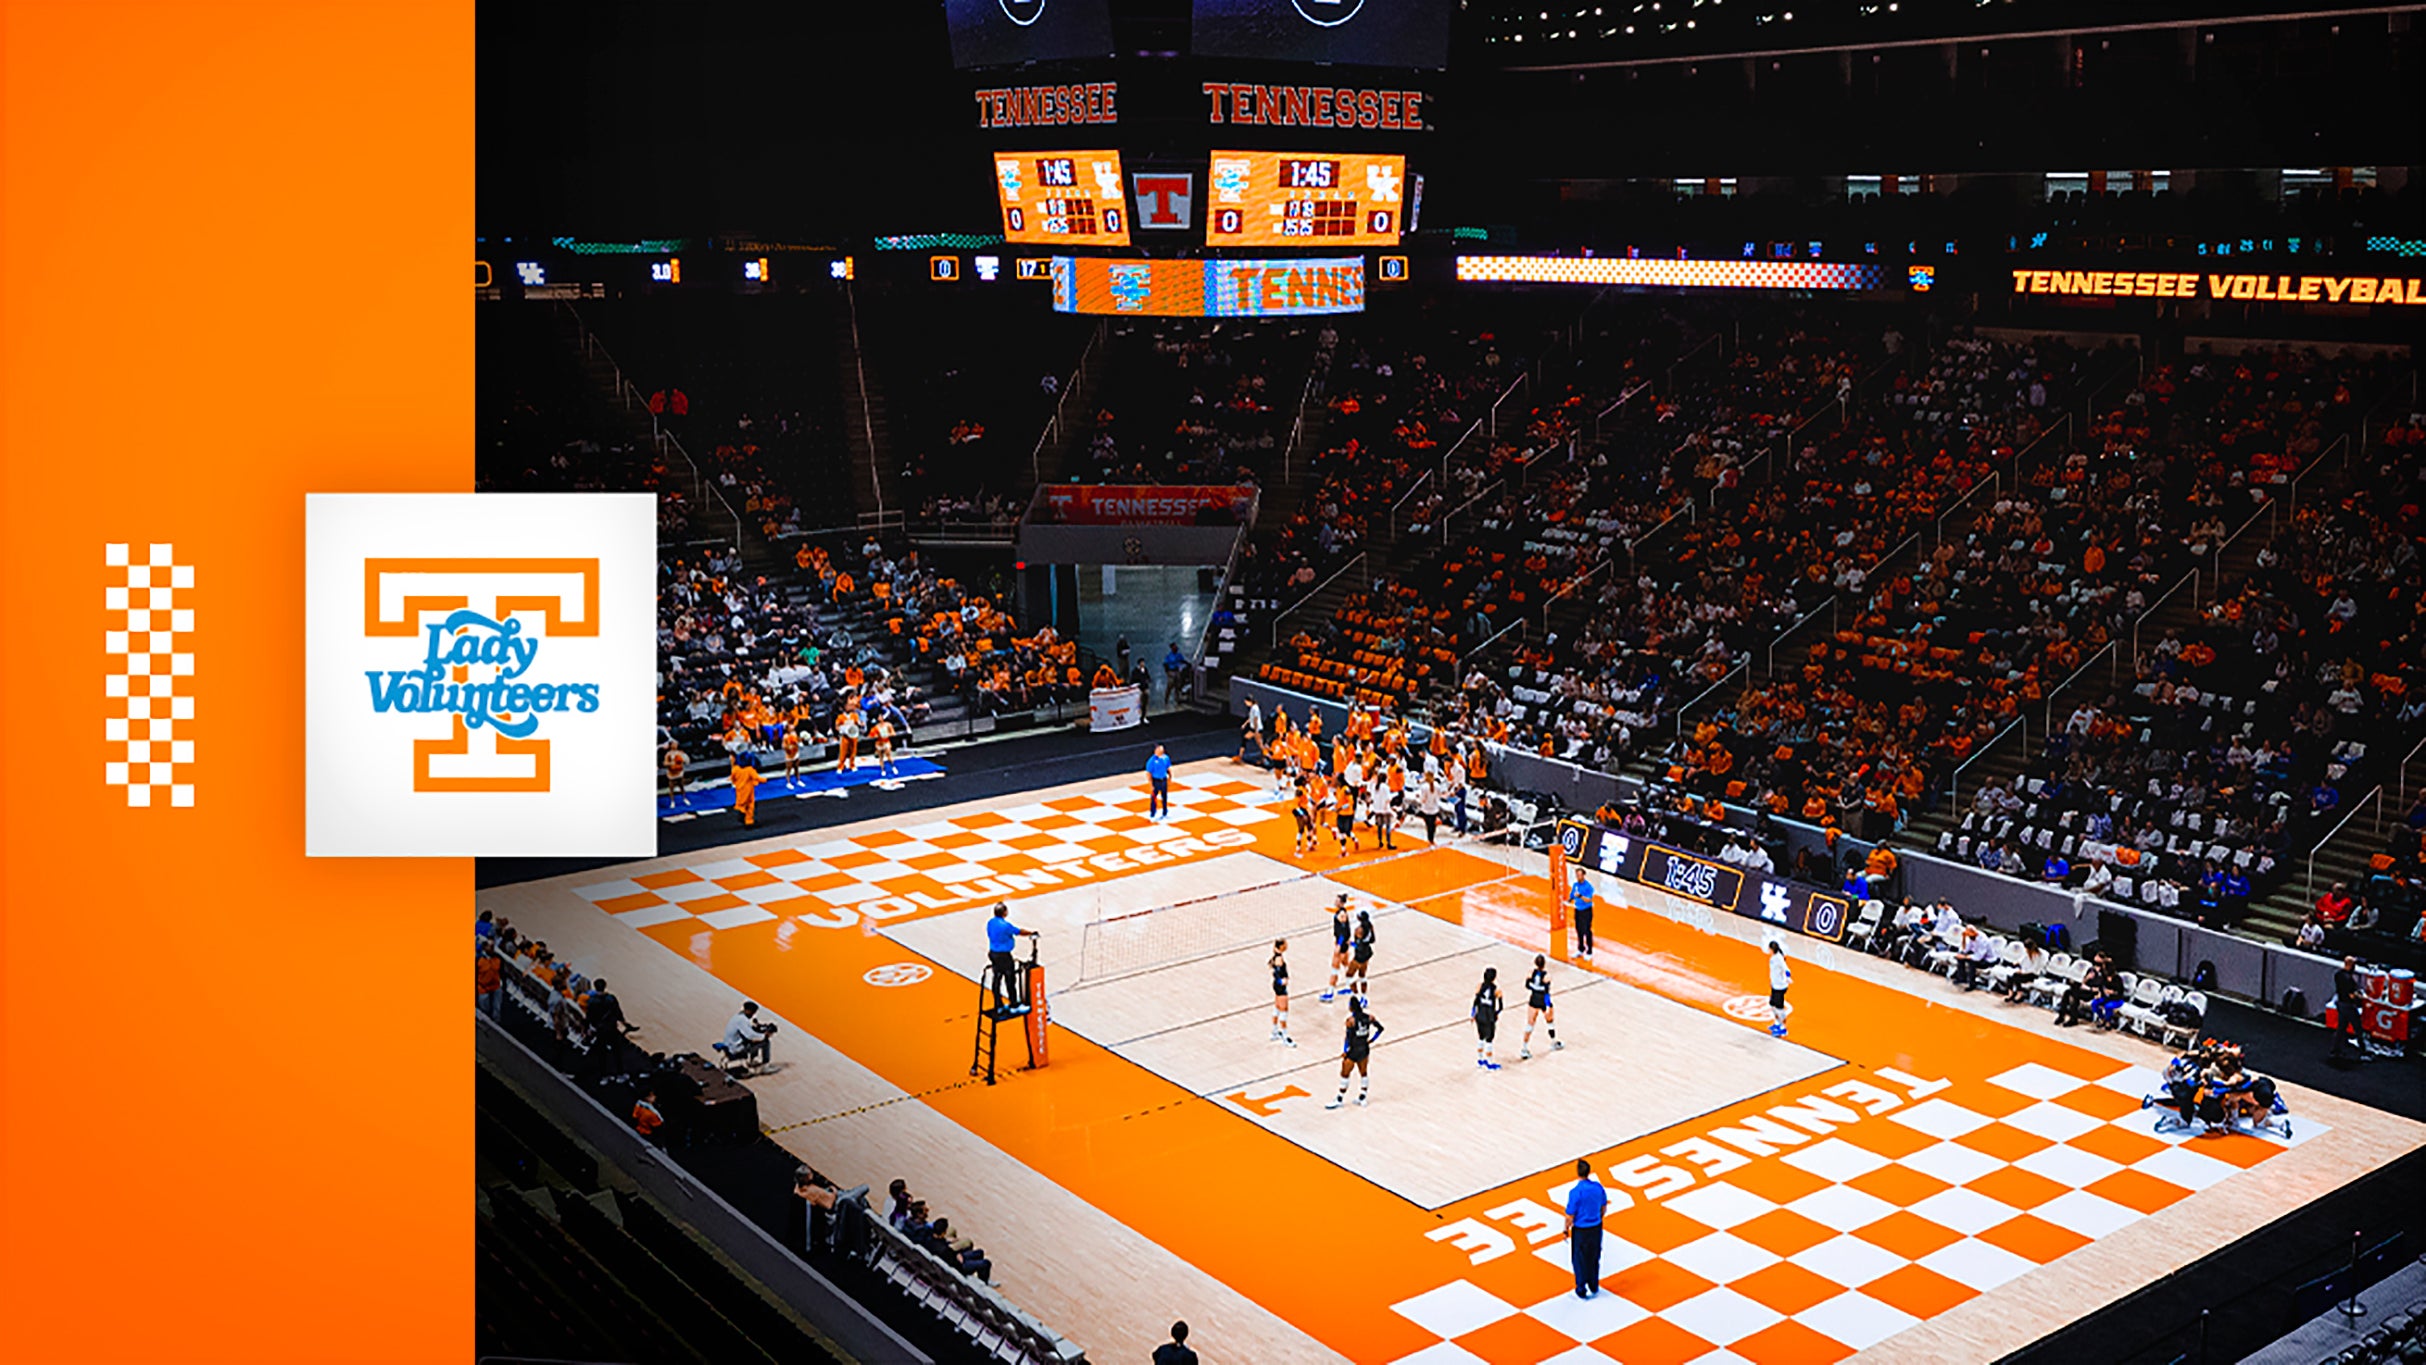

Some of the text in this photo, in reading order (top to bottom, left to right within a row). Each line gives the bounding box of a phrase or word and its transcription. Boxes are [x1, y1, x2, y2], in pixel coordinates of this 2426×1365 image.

[975, 82, 1117, 128] TENNESSEE
[1202, 82, 1422, 130] TENNESSEE
[1043, 159, 1072, 185] 1:45
[1290, 160, 1332, 187] 1:45
[1137, 178, 1189, 224] T
[1011, 208, 1022, 230] 0
[1107, 209, 1119, 232] 0
[1222, 210, 1238, 232] 0
[1374, 212, 1388, 233] 0
[2013, 270, 2426, 304] TENNESSEE VOLLEYBAL
[797, 828, 1258, 930] VOLUNTEERS
[1663, 855, 1718, 899] 1:45
[1815, 902, 1838, 935] 0
[2375, 1009, 2398, 1030] G
